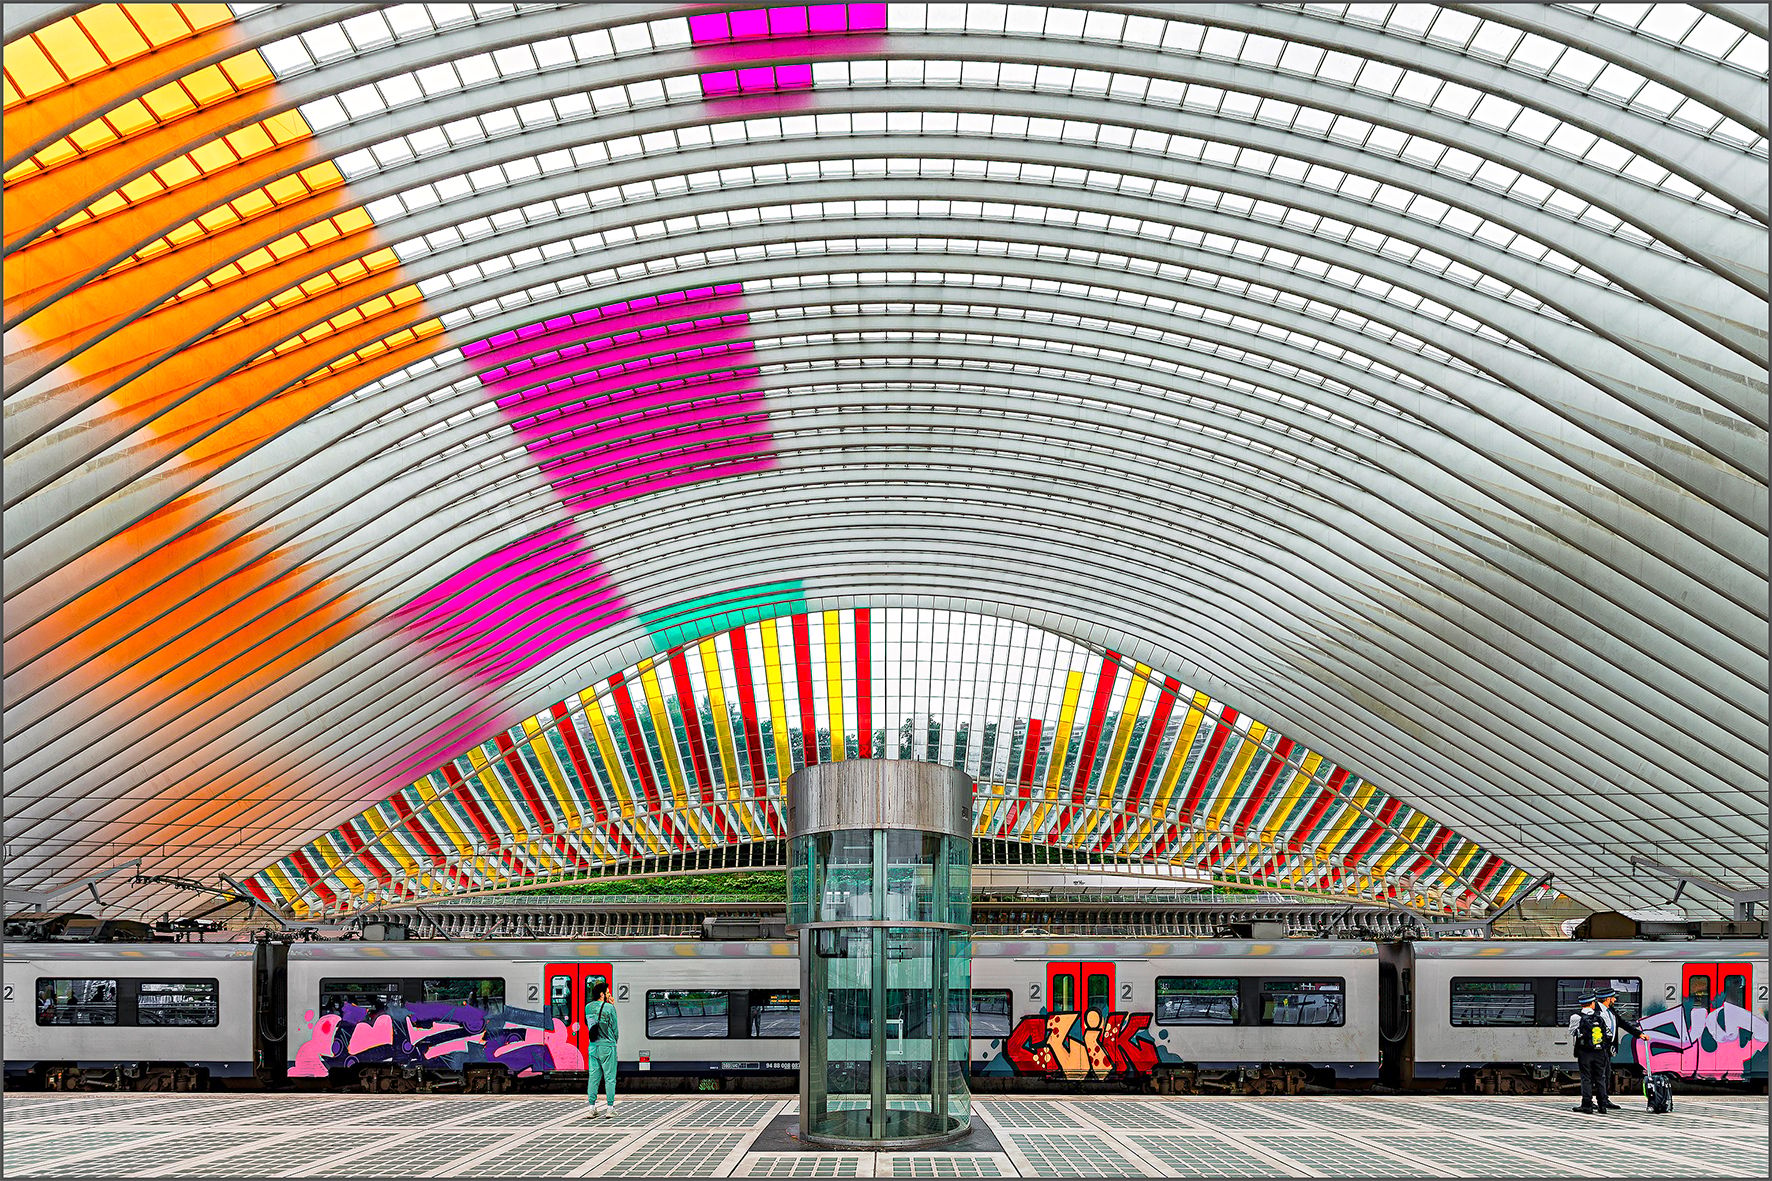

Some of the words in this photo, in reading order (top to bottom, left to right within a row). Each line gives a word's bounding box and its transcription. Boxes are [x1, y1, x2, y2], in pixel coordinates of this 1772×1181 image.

[4, 986, 14, 1000] 2
[528, 986, 539, 1001] 2
[618, 985, 629, 1000] 2
[1030, 984, 1041, 1000] 2
[1121, 984, 1132, 1000] 2
[1665, 985, 1676, 1001] 2
[1758, 985, 1769, 1001] 2
